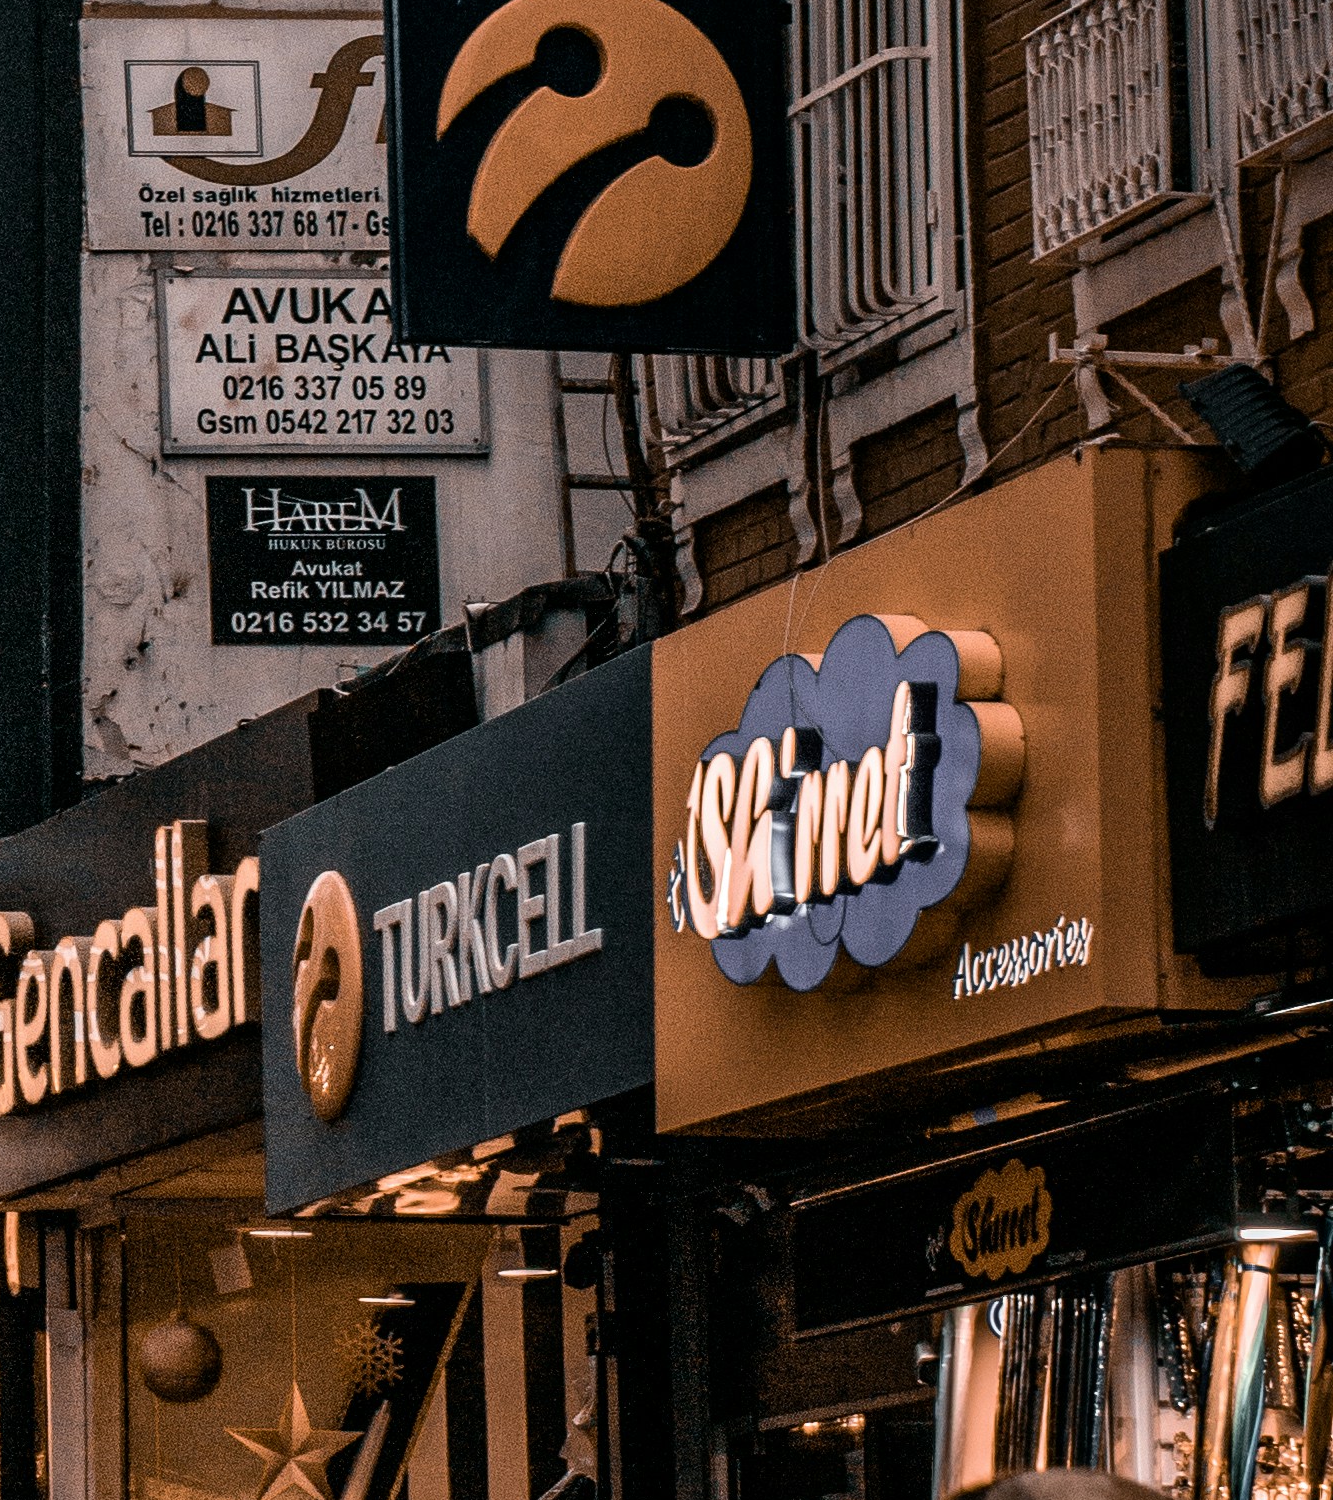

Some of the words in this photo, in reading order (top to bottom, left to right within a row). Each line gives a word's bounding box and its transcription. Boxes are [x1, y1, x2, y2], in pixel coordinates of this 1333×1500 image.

[138, 183, 185, 203] Özel
[192, 186, 257, 206] sağlık
[271, 186, 381, 203] hizmetleri
[141, 211, 171, 238] Tel
[192, 211, 240, 238] 0216
[248, 211, 284, 238] 337
[293, 211, 318, 238] 68
[223, 375, 284, 401] 0216
[293, 375, 342, 401] 337
[352, 375, 385, 401] 05
[395, 375, 427, 401] 89
[197, 408, 257, 436] Gsm
[266, 408, 328, 436] 0542
[336, 408, 378, 436] 217
[387, 408, 417, 436] 32
[424, 408, 455, 436] 03
[241, 487, 407, 532] HAREM
[268, 538, 323, 551] HUKUK
[326, 536, 387, 551] BÜROSU
[291, 560, 364, 577] Avukat
[250, 581, 310, 600] Refik
[317, 581, 406, 600] YILMAZ
[231, 611, 295, 634] 0216
[302, 611, 349, 634] 532
[357, 611, 390, 634] 34
[397, 611, 427, 633] 57
[373, 821, 603, 1033] TURKCELL
[951, 911, 1096, 1000] Accessories
